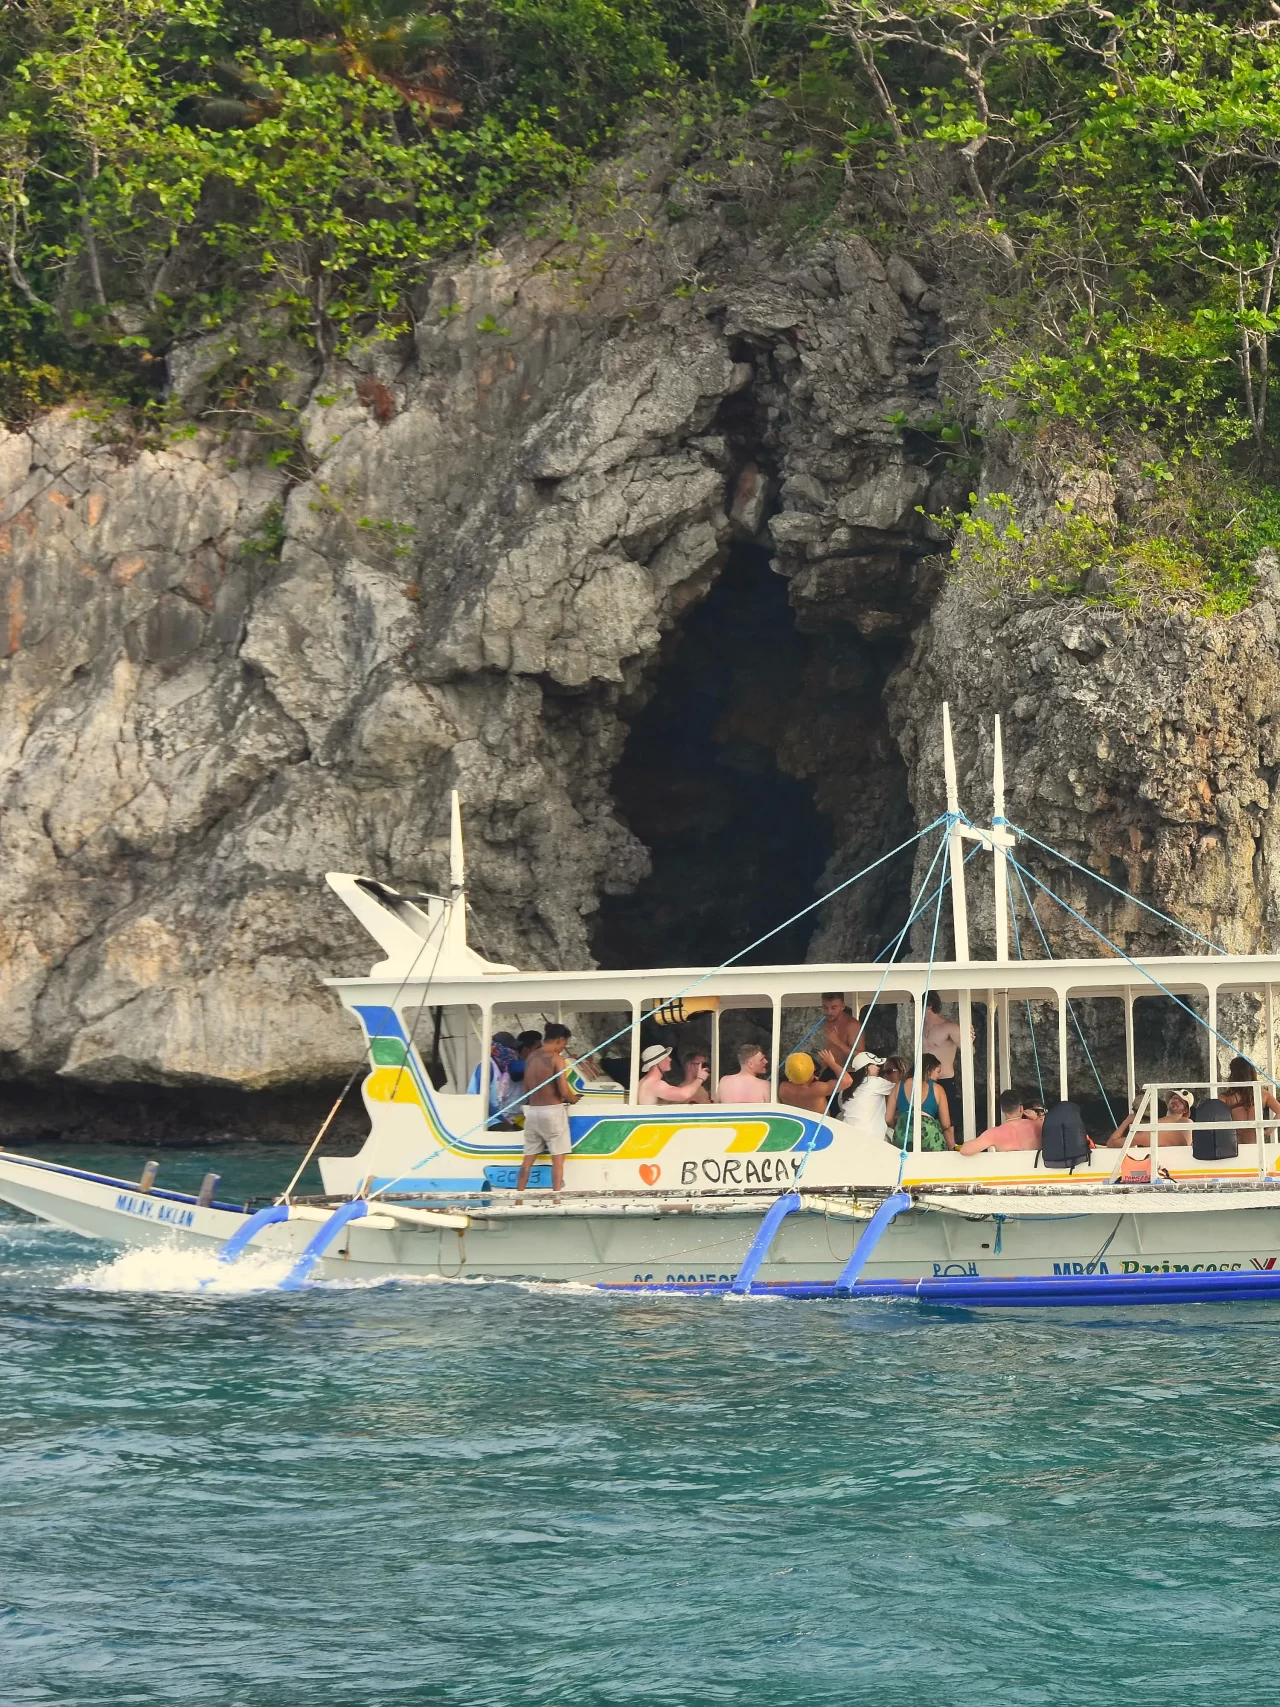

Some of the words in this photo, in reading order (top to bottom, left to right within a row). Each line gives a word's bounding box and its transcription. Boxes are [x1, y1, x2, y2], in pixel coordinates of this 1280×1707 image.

[681, 1158, 804, 1185] BORACAY
[157, 1204, 196, 1227] AKLAN
[1119, 1260, 1242, 1274] Princess
